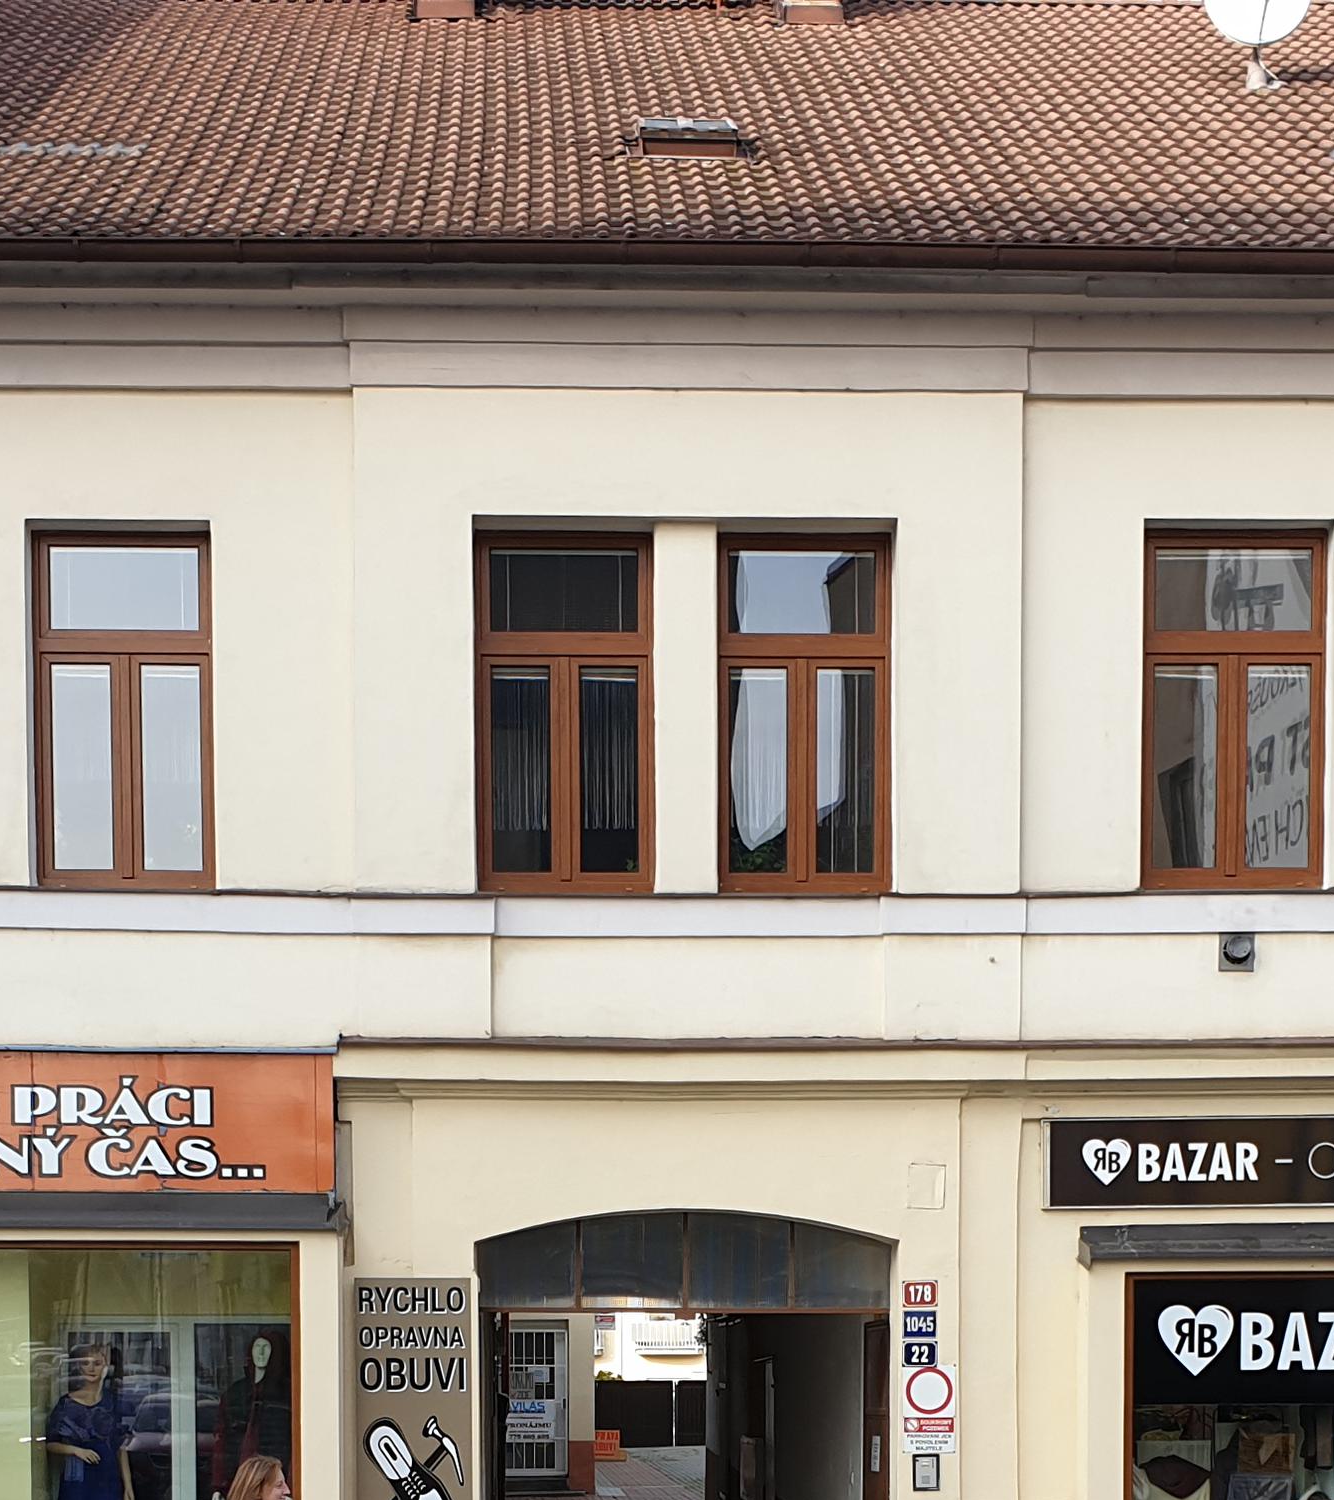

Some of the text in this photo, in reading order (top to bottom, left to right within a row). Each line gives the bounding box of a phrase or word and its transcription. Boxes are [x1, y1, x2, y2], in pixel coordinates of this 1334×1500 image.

[10, 1075, 214, 1128] PRÁCI
[1137, 1141, 1259, 1183] BAZAR
[358, 1286, 466, 1314] RYCHLO
[909, 1284, 932, 1303] 178
[905, 1316, 934, 1332] 1045
[359, 1326, 466, 1349] OPRAVNA
[911, 1345, 929, 1363] 22
[359, 1357, 467, 1392] OBUVI
